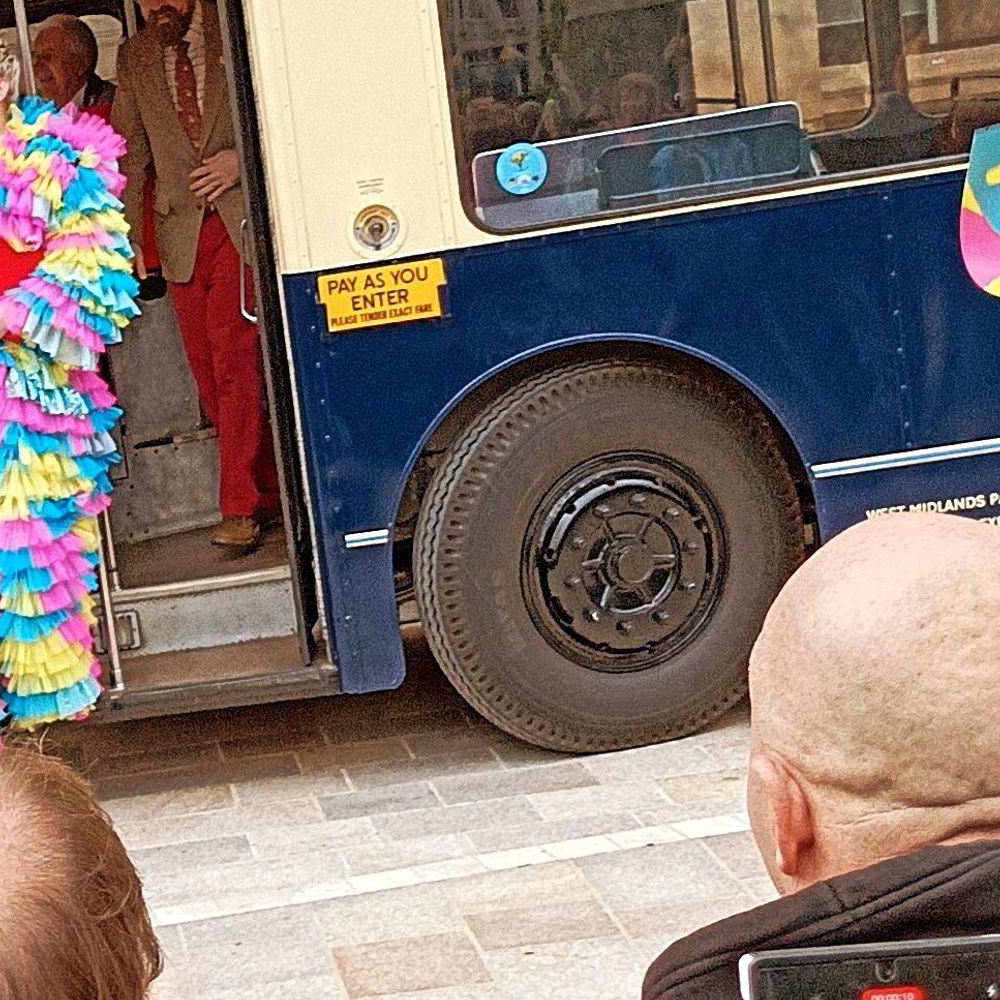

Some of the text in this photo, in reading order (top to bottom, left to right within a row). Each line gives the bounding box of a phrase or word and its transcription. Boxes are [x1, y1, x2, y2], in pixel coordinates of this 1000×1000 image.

[327, 266, 428, 295] PAY AS YOU
[351, 289, 408, 311] ENTER
[331, 315, 358, 326] PLEASE
[360, 311, 387, 322] TENDER
[389, 307, 412, 318] EXACT
[910, 495, 985, 512] MIDLANDS
